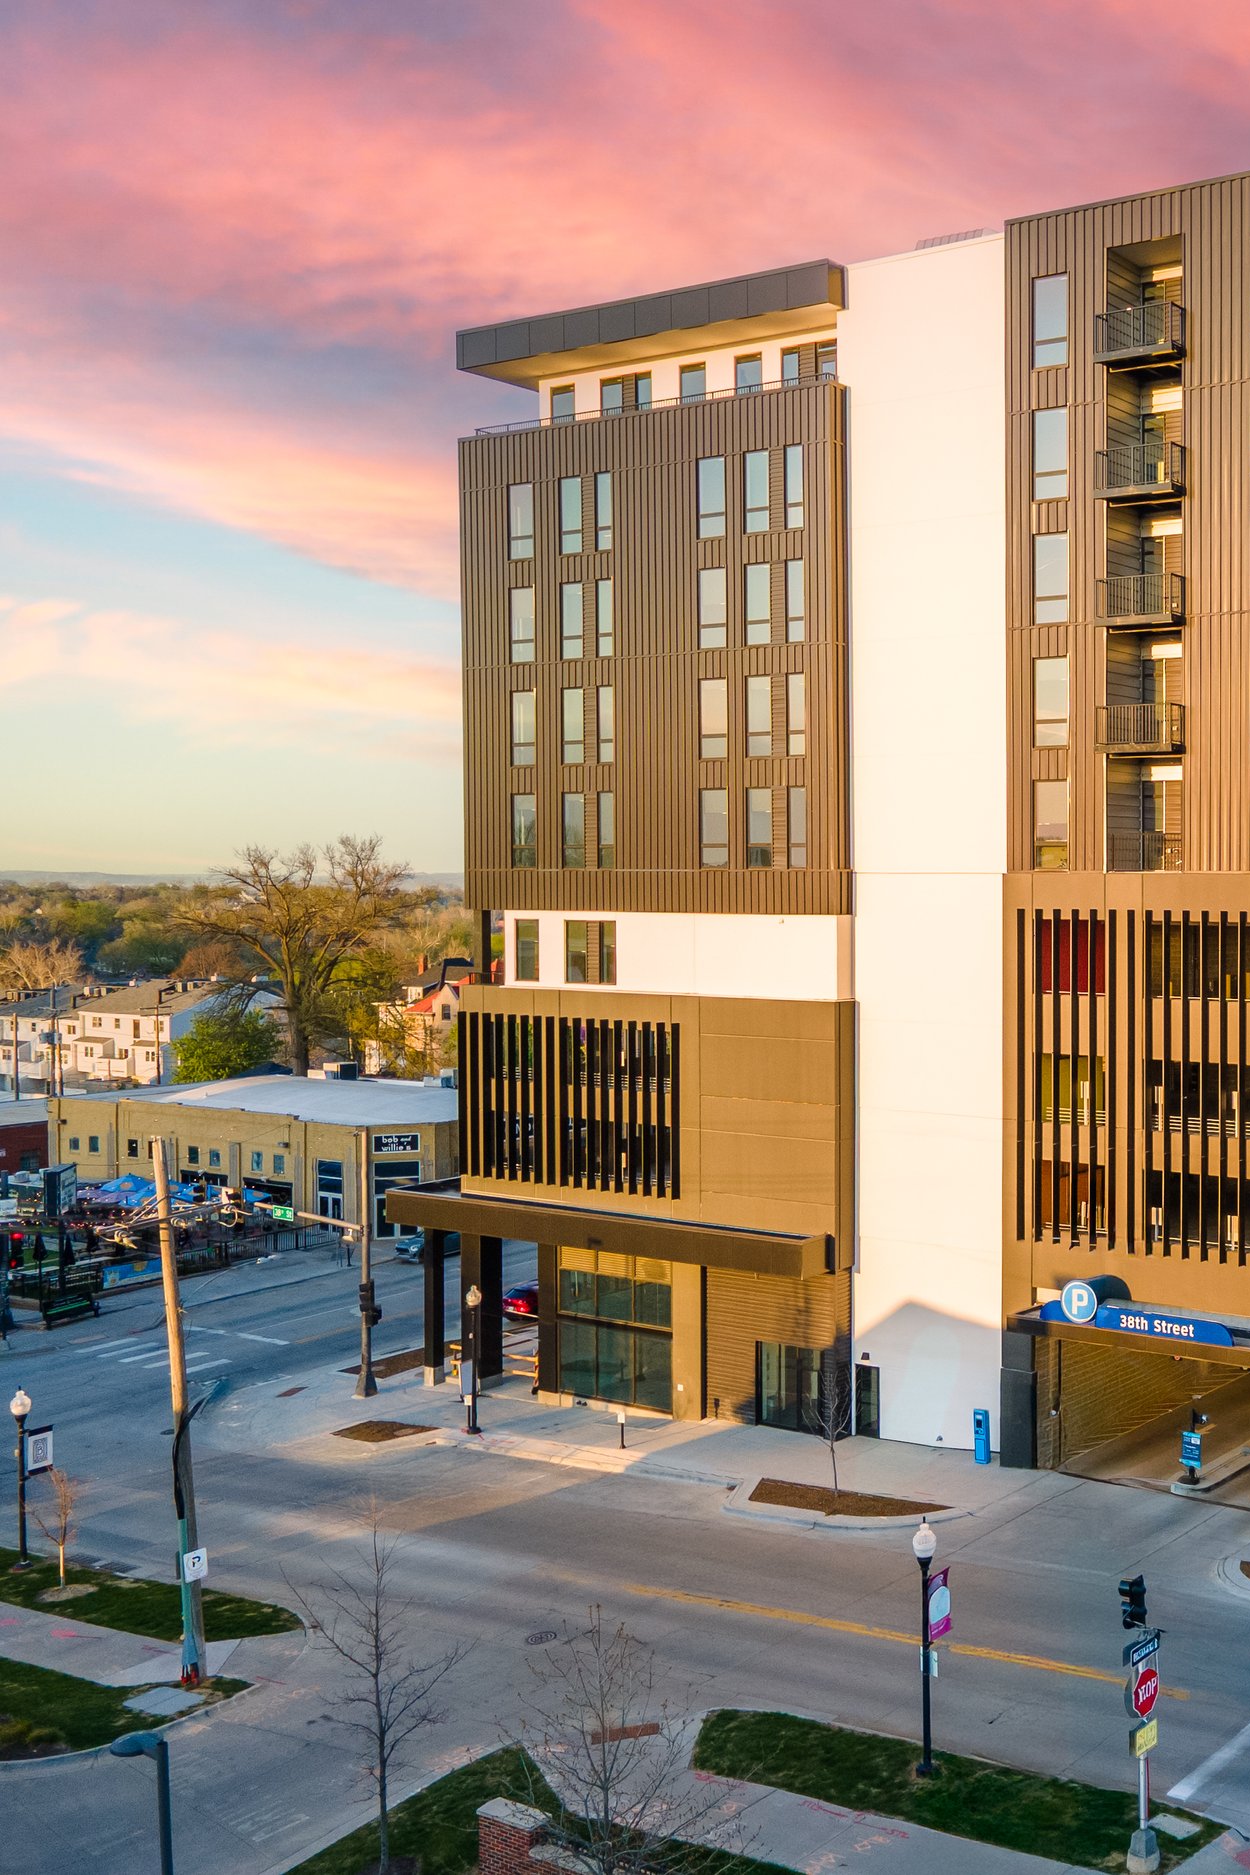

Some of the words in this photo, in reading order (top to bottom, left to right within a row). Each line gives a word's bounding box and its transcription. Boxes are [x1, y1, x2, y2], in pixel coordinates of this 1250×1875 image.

[381, 1142, 412, 1151] willie's
[382, 1135, 399, 1143] bob
[1071, 1288, 1089, 1315] P
[1119, 1314, 1149, 1331] 38th
[1153, 1319, 1195, 1338] Street
